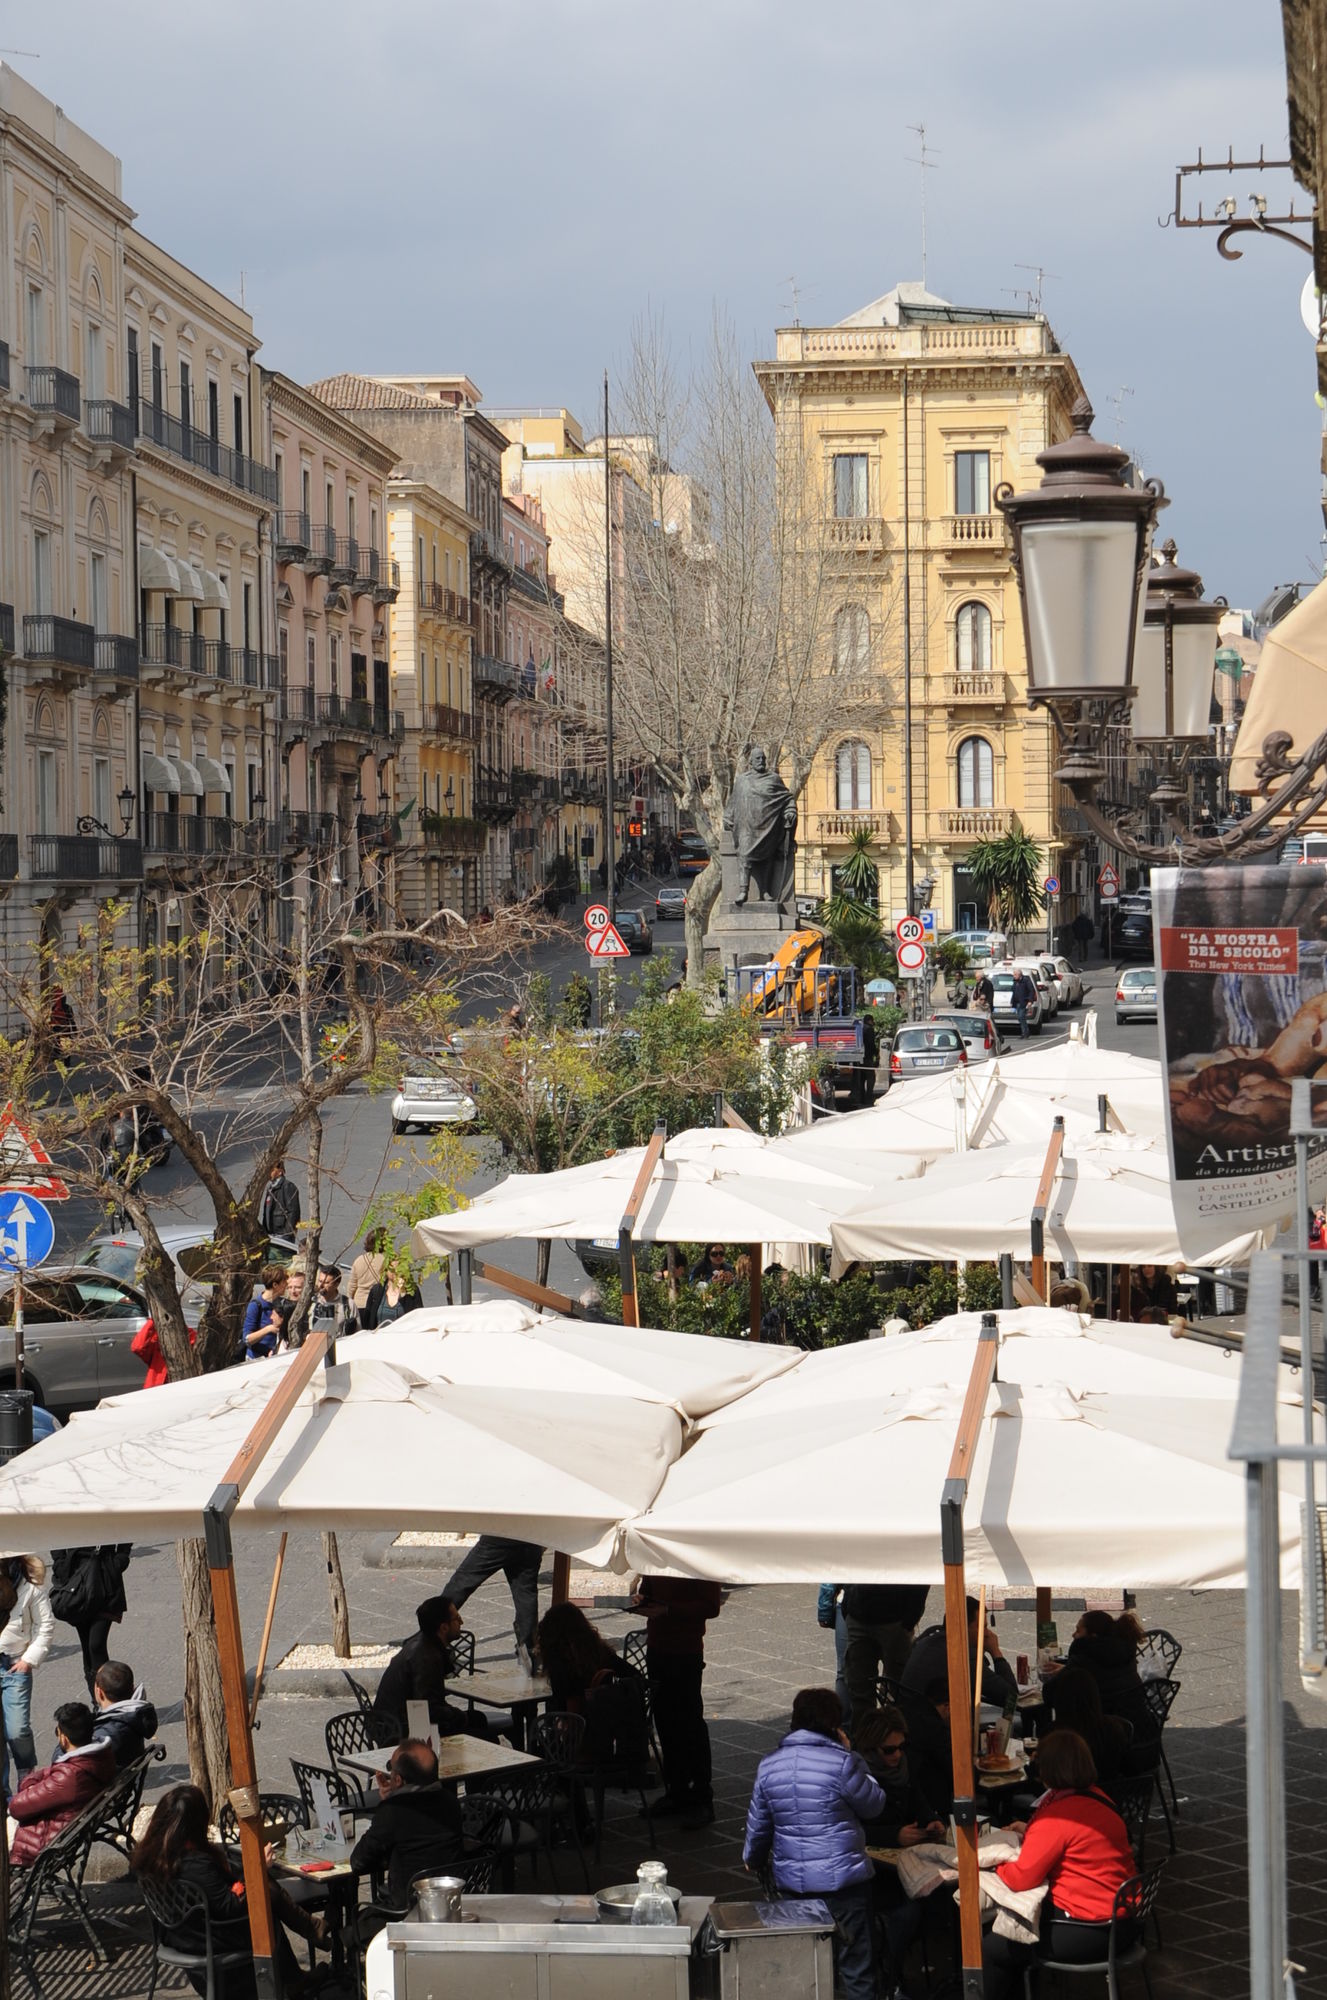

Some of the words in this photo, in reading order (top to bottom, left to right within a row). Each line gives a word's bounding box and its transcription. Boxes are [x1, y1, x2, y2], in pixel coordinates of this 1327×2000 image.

[591, 913, 605, 925] 20
[920, 914, 931, 924] P
[903, 924, 918, 937] 20
[1214, 934, 1279, 945] MOSTRA
[1188, 946, 1219, 957] DEL
[1223, 947, 1290, 958] SECOLO”
[1188, 960, 1206, 969] The
[1209, 961, 1229, 970] New
[1231, 961, 1254, 970] York
[1256, 962, 1286, 971] Times
[1195, 1168, 1211, 1176] da
[1216, 1162, 1283, 1175] Pirandello
[1212, 1182, 1247, 1191] cura
[1253, 1177, 1268, 1186] di
[1219, 1187, 1275, 1202] gennaio
[1198, 1193, 1278, 1212] CASTELLO
